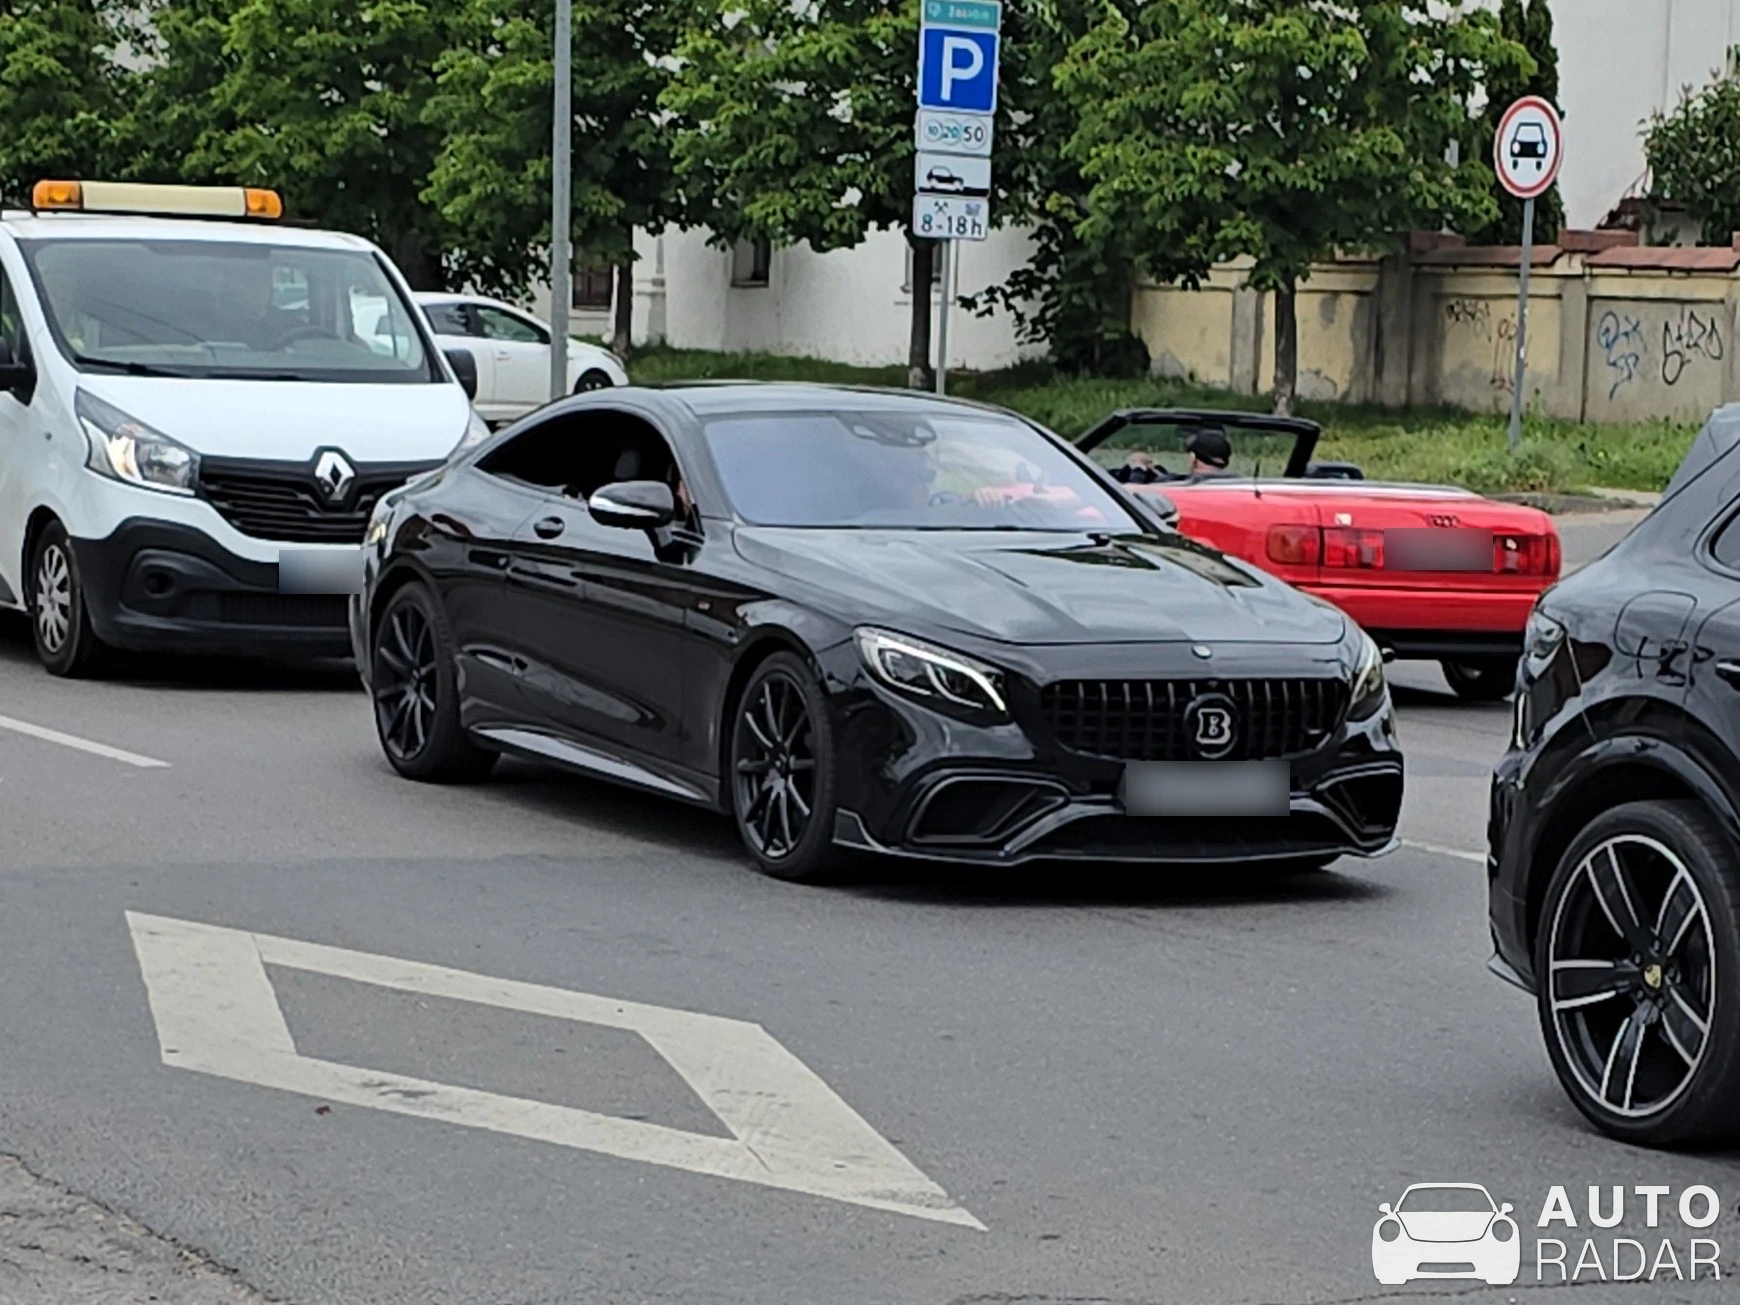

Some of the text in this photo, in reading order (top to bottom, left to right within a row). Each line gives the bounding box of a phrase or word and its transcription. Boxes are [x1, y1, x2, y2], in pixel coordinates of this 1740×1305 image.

[941, 36, 984, 101] P
[963, 126, 984, 143] 50
[1196, 708, 1231, 744] B
